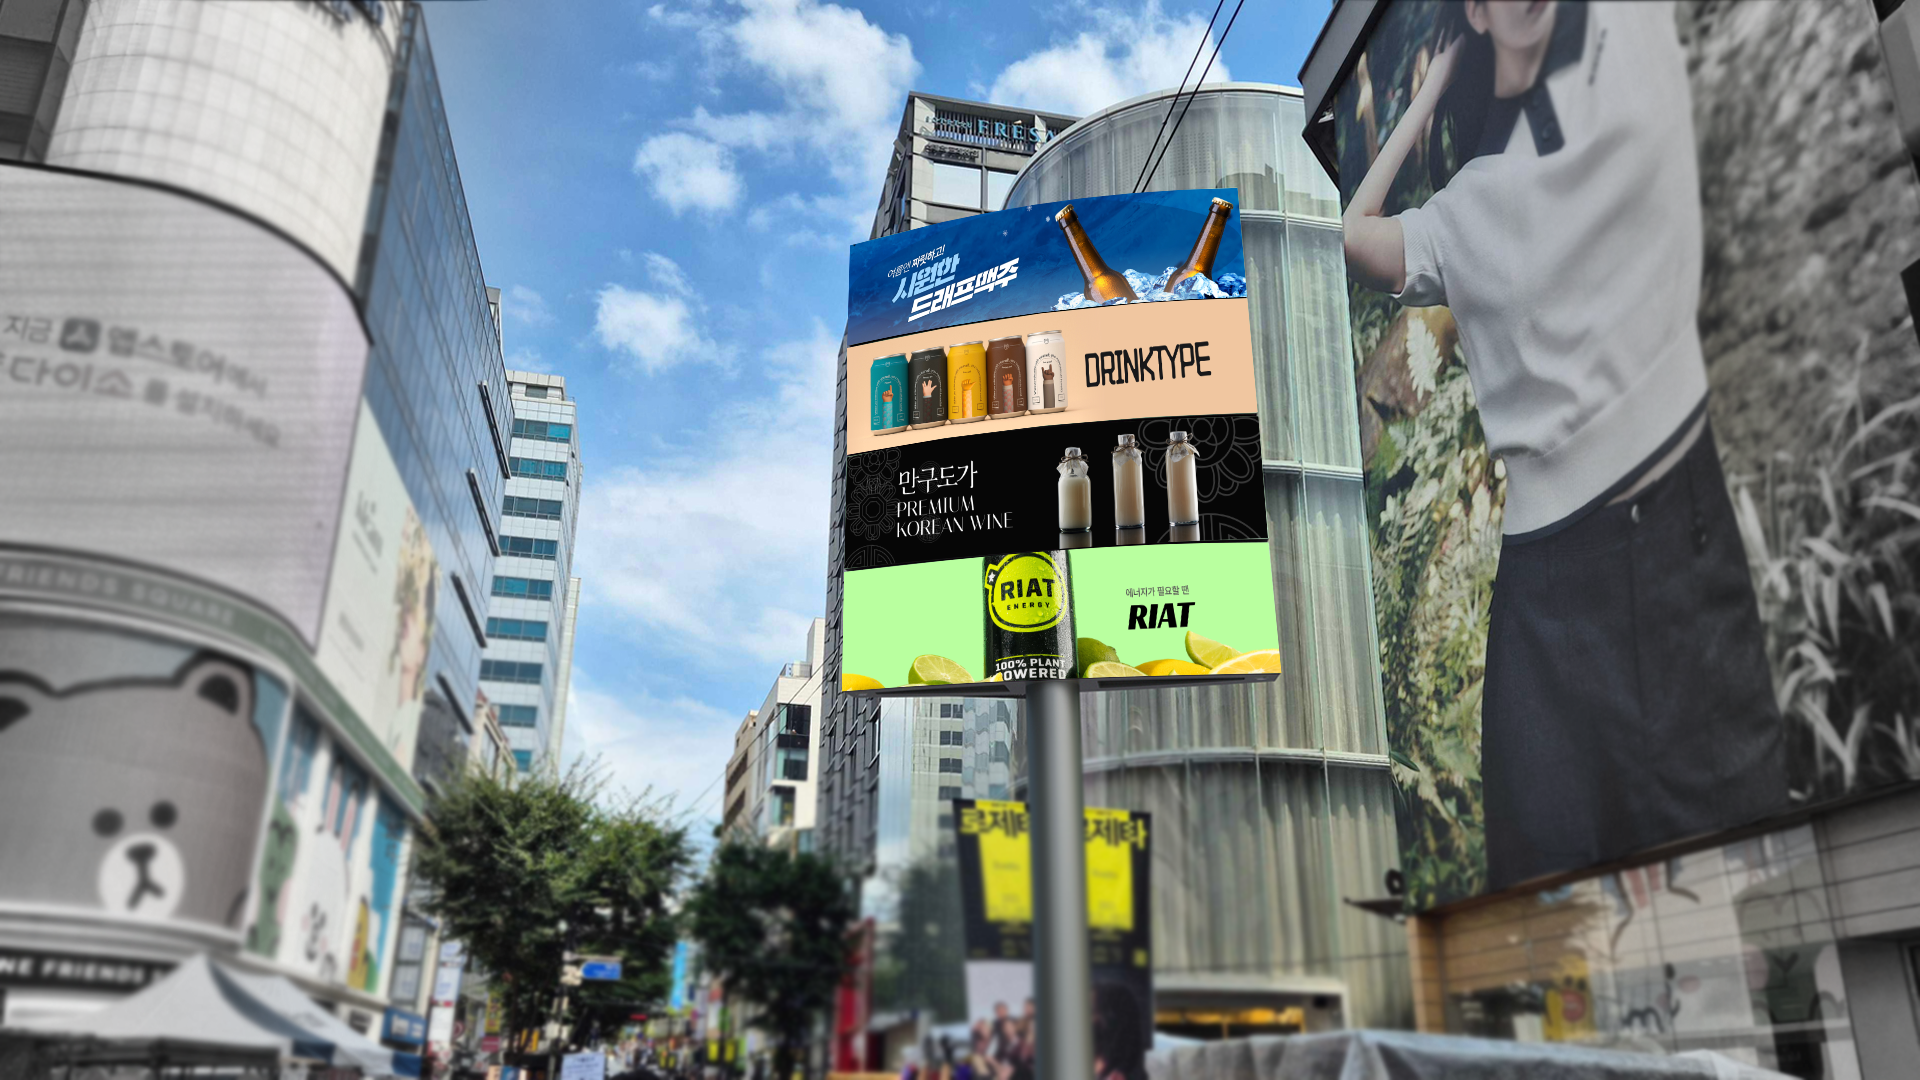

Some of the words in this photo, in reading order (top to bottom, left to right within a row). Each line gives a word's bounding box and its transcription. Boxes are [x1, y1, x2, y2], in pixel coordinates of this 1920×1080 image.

[887, 260, 912, 278] 여름엔
[911, 244, 946, 269] 짜릿하고!
[892, 252, 960, 303] 시원한
[908, 257, 1019, 322] 드래프맥주
[3, 315, 52, 344] 지금
[0, 353, 134, 399] 다이소
[1084, 341, 1211, 387] DRINKTYPE
[898, 460, 978, 495] 만구도가
[897, 495, 975, 518] PREMIUM
[896, 516, 964, 538] KOREAN
[970, 511, 1014, 531] WINE
[0, 563, 118, 595] RIENDS
[1000, 578, 1055, 601] RIAT
[1125, 587, 1155, 598] 에너지가
[1157, 585, 1180, 597] 필요할
[1181, 584, 1190, 595] 땐
[1006, 601, 1050, 611] ENERGY
[1127, 601, 1196, 631] RIAT
[995, 659, 1027, 672] 100%
[1029, 657, 1066, 668] PLANT
[1002, 667, 1067, 681] OWERED
[42, 960, 145, 985] FRIENDS
